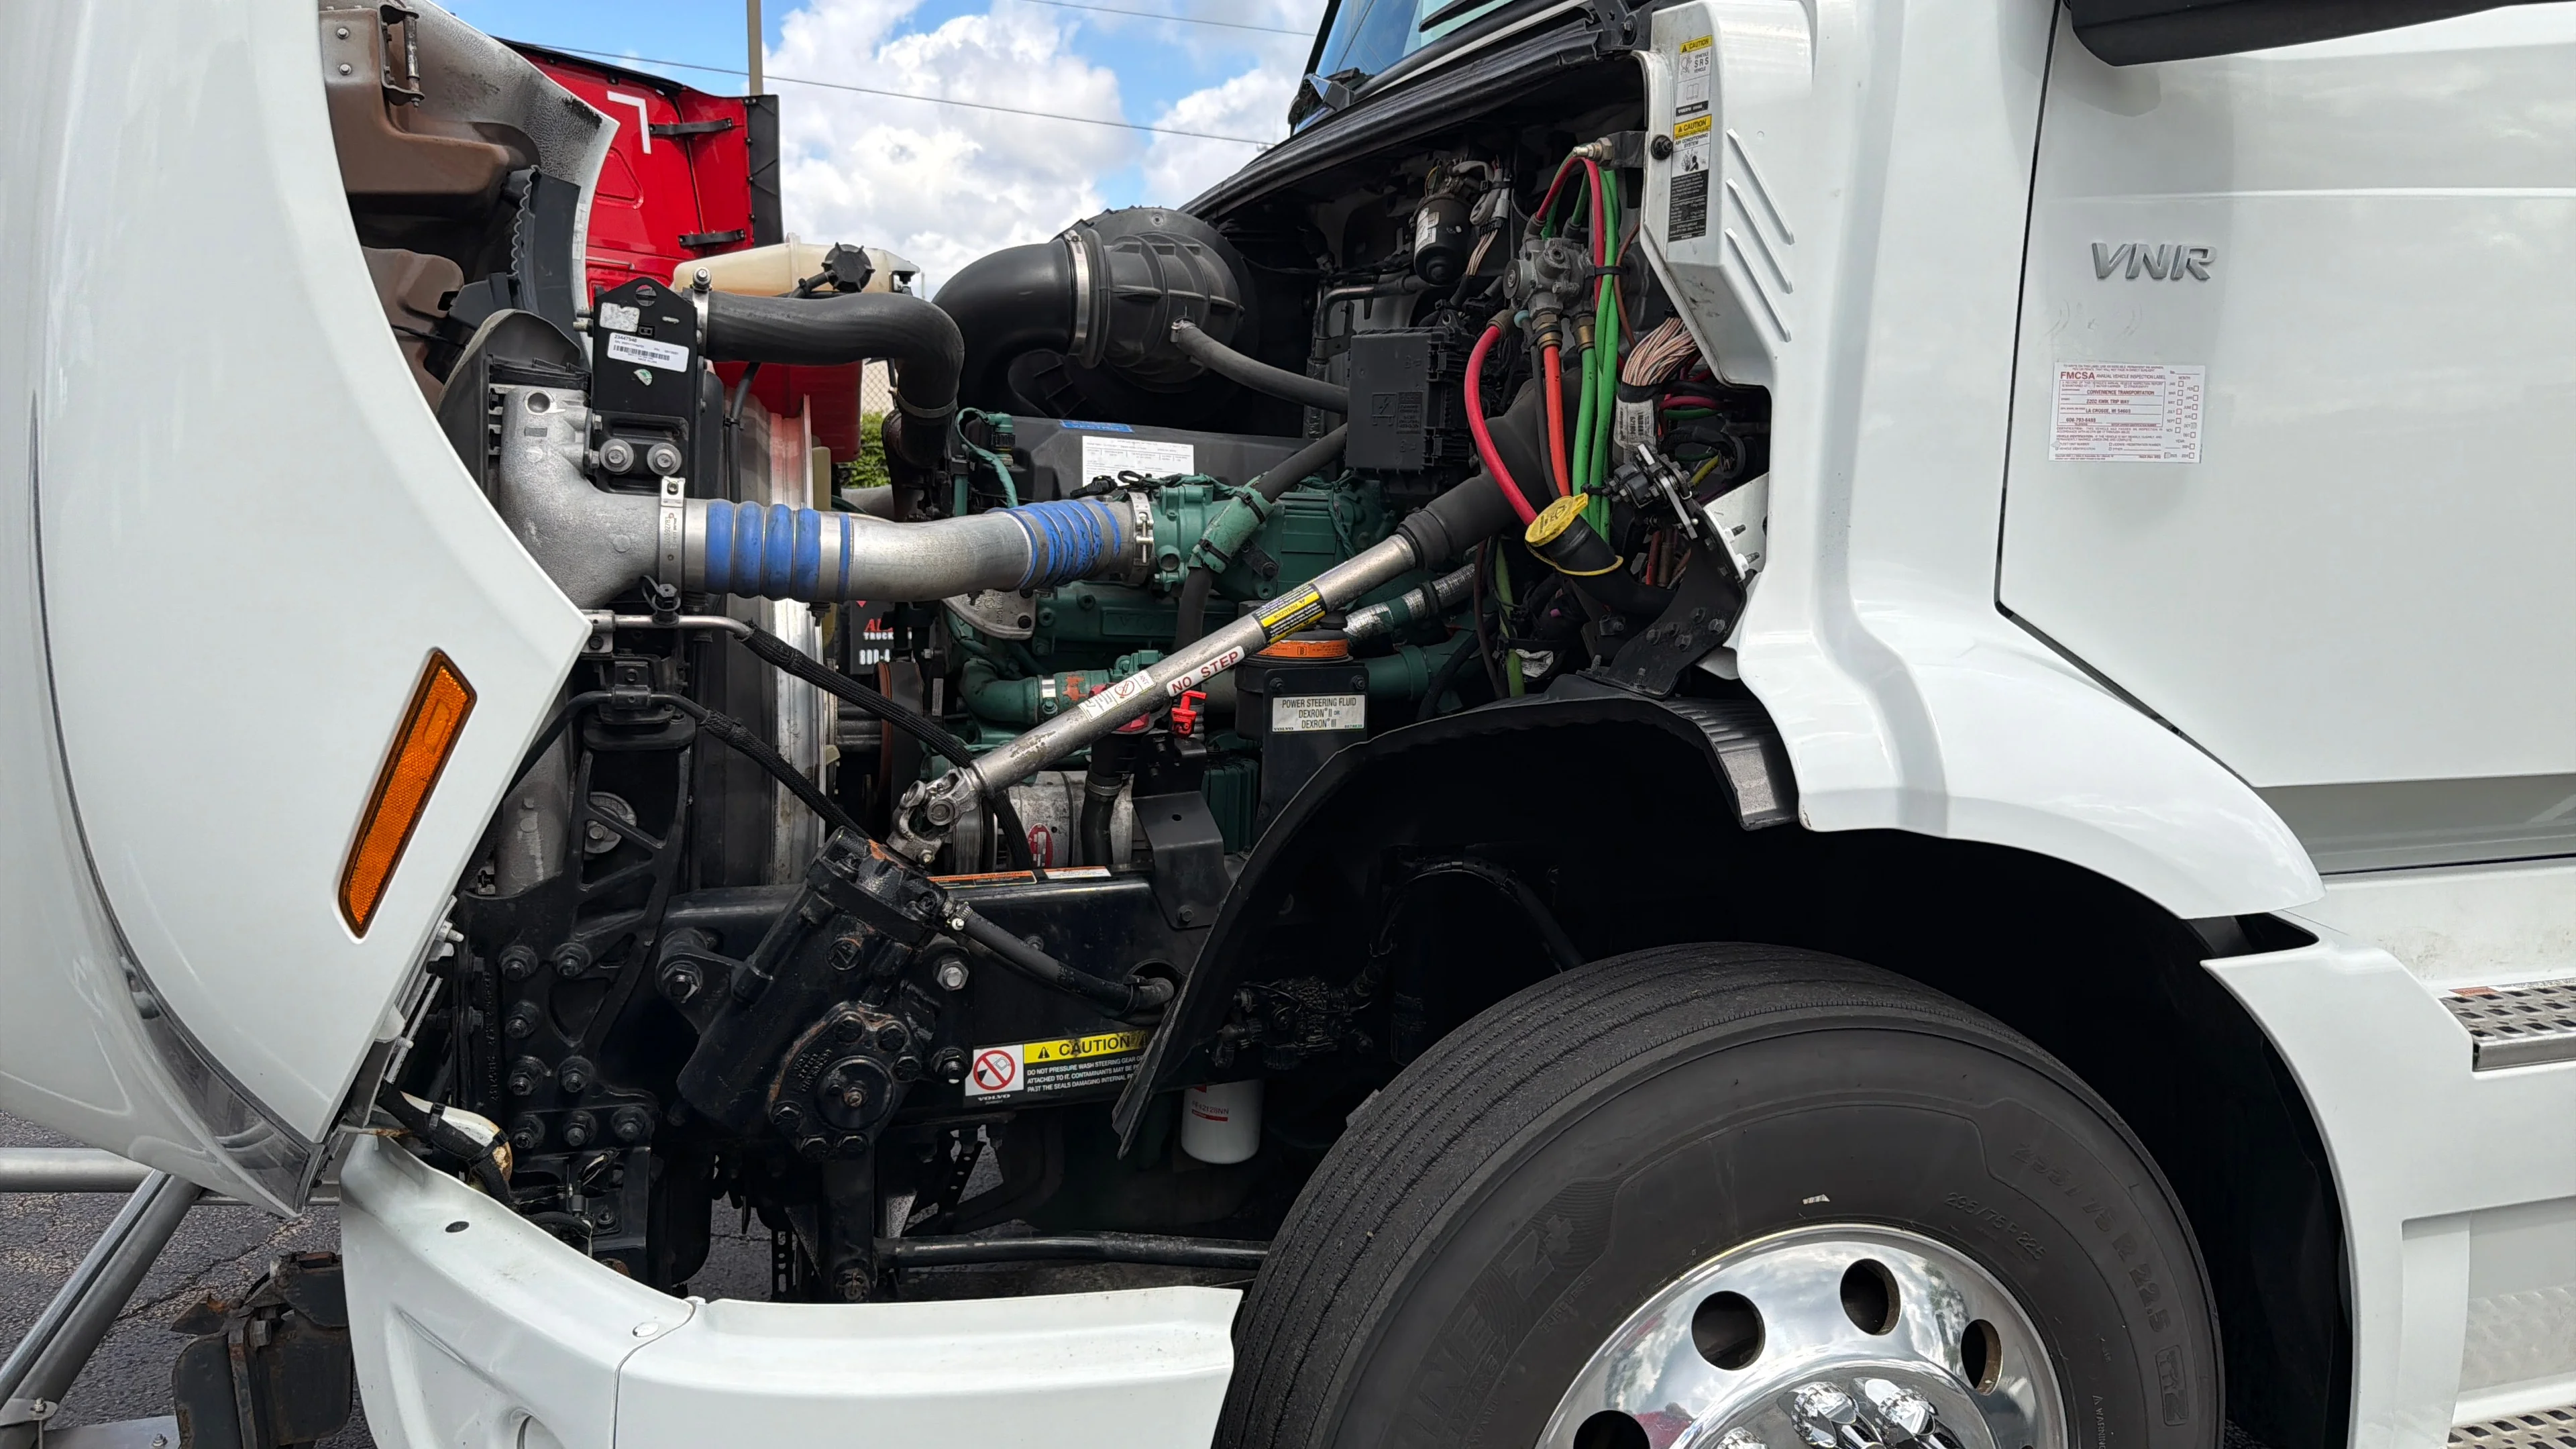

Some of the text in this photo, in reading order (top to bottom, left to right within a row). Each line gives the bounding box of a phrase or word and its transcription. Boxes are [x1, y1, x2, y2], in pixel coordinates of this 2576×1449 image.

[1689, 38, 1709, 49] CAUTION
[1683, 119, 1707, 131] CAUTION
[1682, 133, 1708, 143] CONDITIONING
[2091, 242, 2217, 280] VNR
[2060, 372, 2095, 380] FMCSA
[1171, 651, 1238, 694] NO STEP
[1282, 697, 1356, 708] POWER STEERING FLUID
[1328, 708, 1332, 717] II
[1059, 1035, 1130, 1057] CAUTION
[1049, 1064, 1077, 1074] PRESSURE
[1095, 1059, 1120, 1068] STEERING
[1027, 1075, 1055, 1084] ATTACHED
[1071, 1069, 1112, 1079] CONTAMINANTS
[1054, 1081, 1071, 1089] SEALS
[1071, 1078, 1100, 1087] DAMAGING
[1101, 1075, 1126, 1083] INTERNAL
[977, 1093, 1011, 1102] VOLVO
[1944, 1191, 2008, 1229] 295/75
